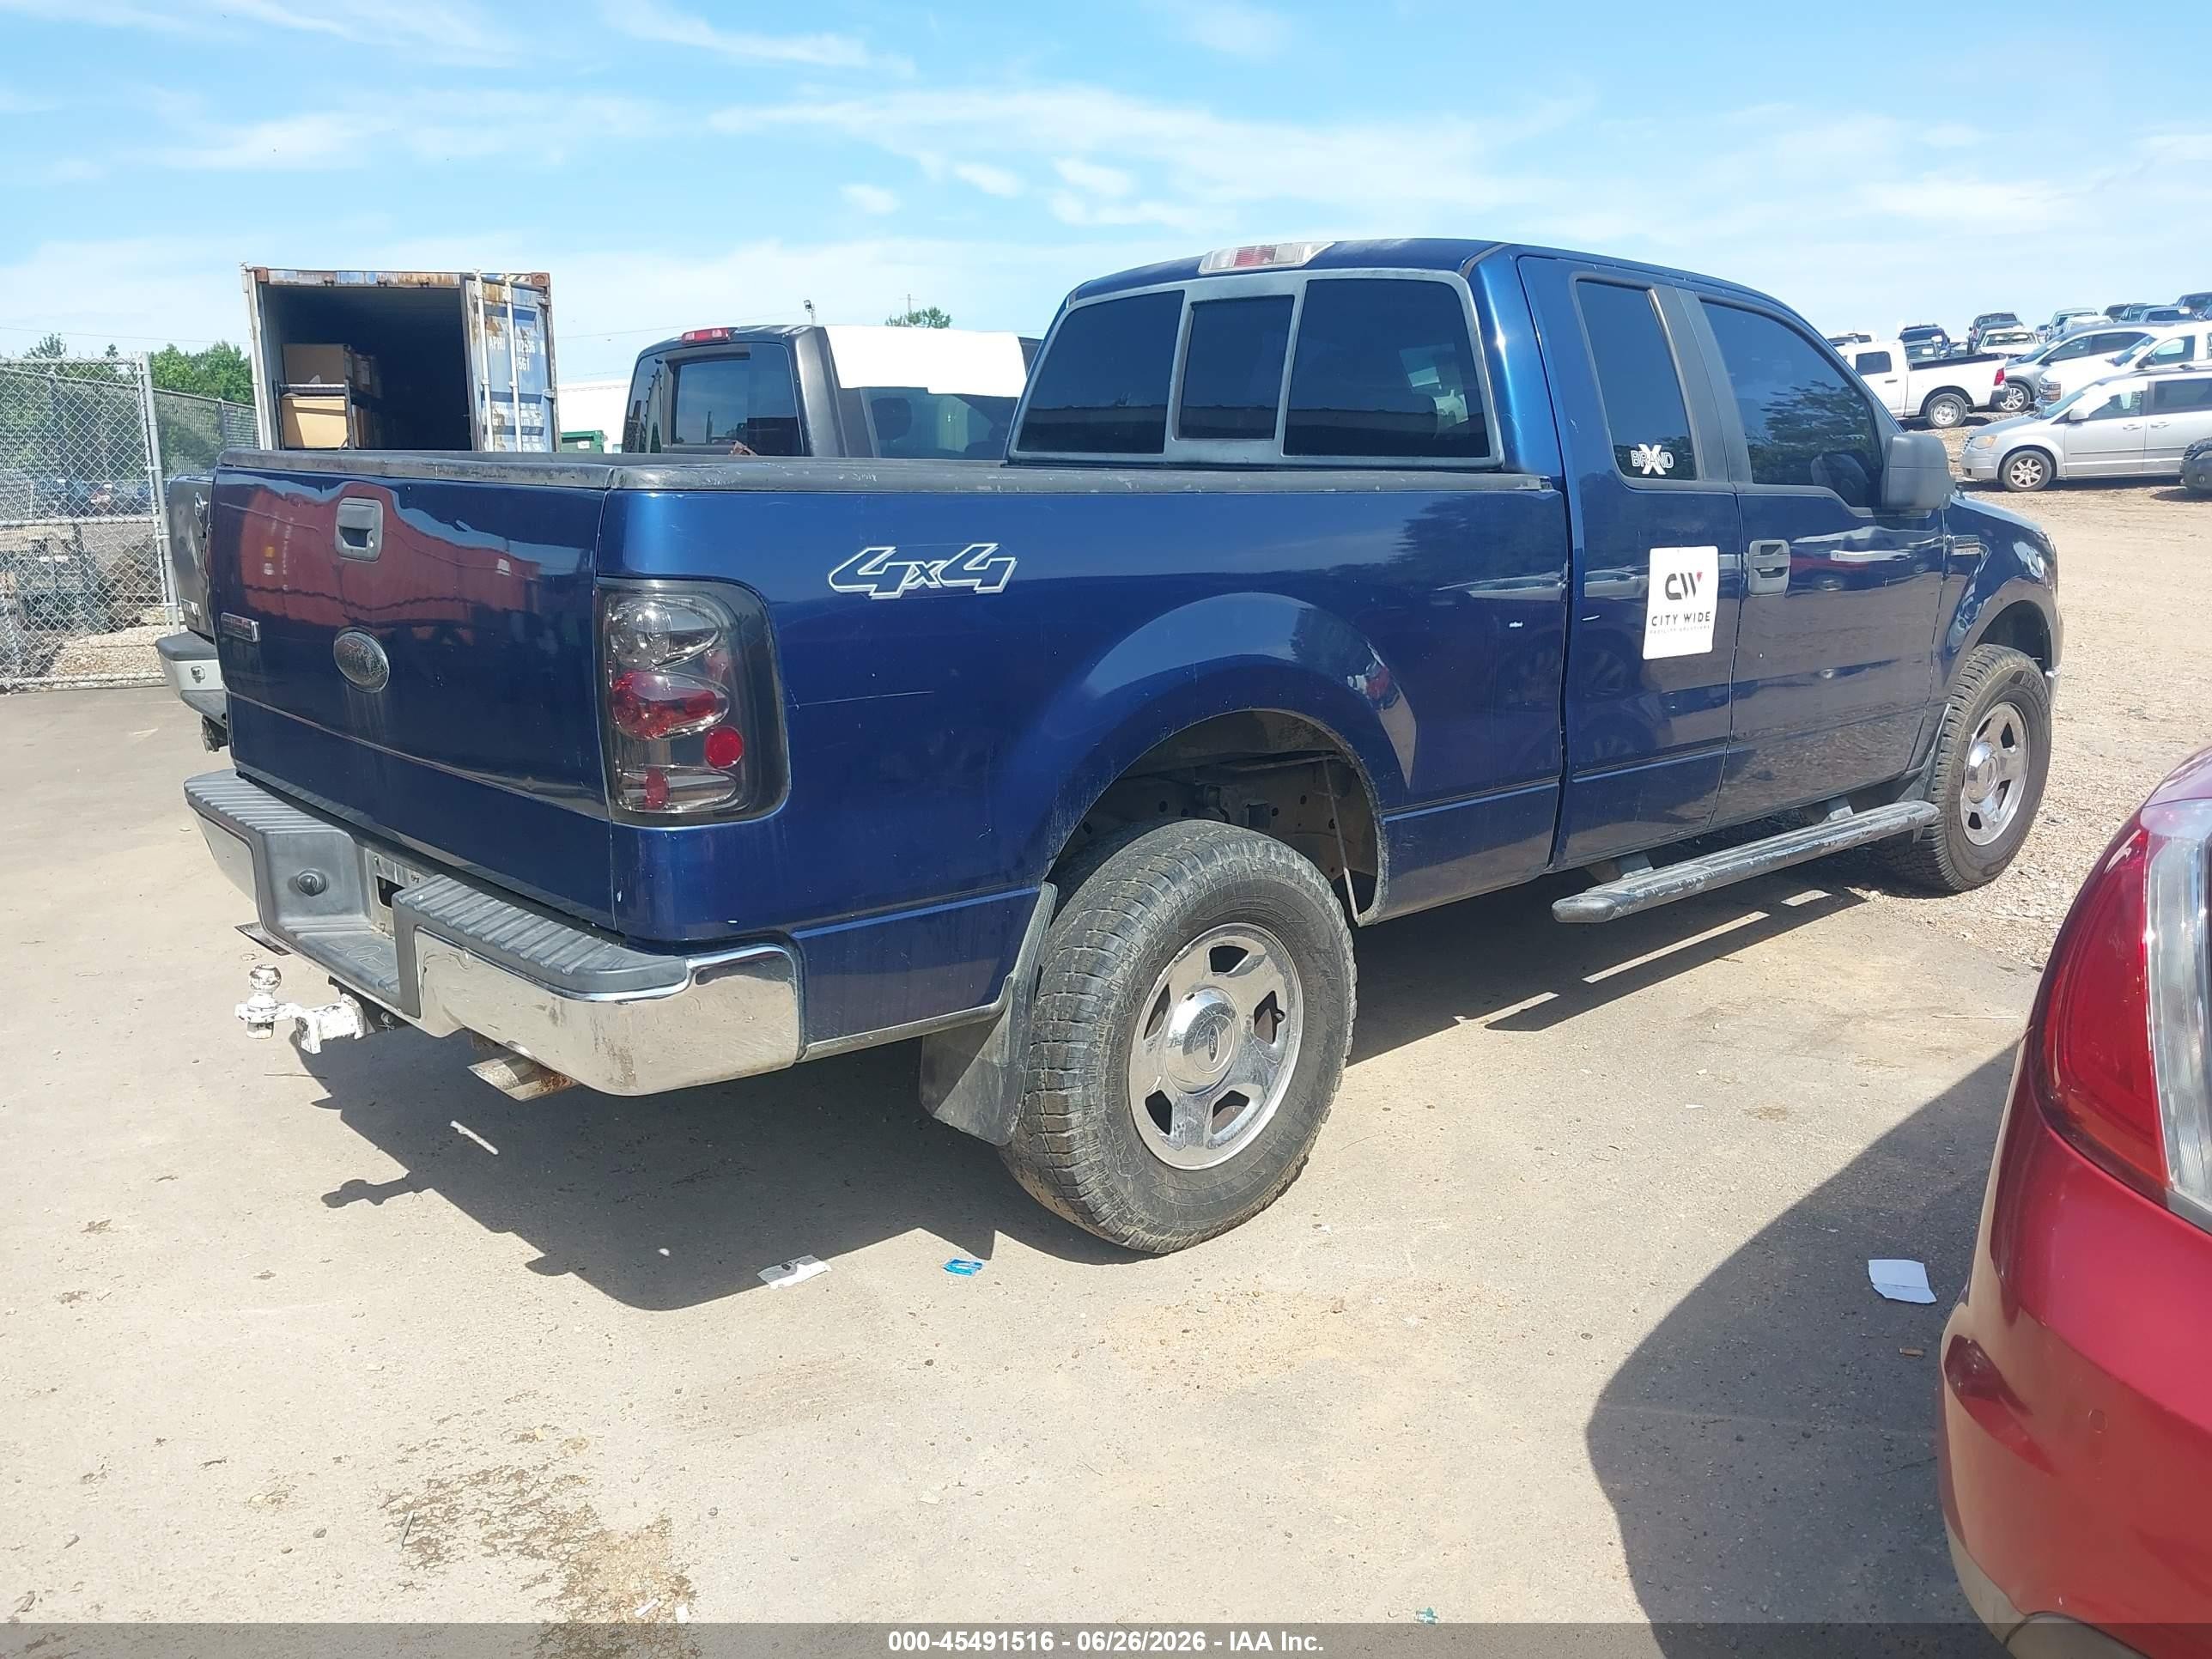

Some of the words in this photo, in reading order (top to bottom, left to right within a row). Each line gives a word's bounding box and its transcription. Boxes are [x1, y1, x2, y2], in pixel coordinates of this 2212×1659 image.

[1630, 449, 1674, 469] BRAND
[828, 543, 1018, 599] 4x4
[1651, 613, 1679, 627] CITY
[1683, 611, 1711, 624] WIDE
